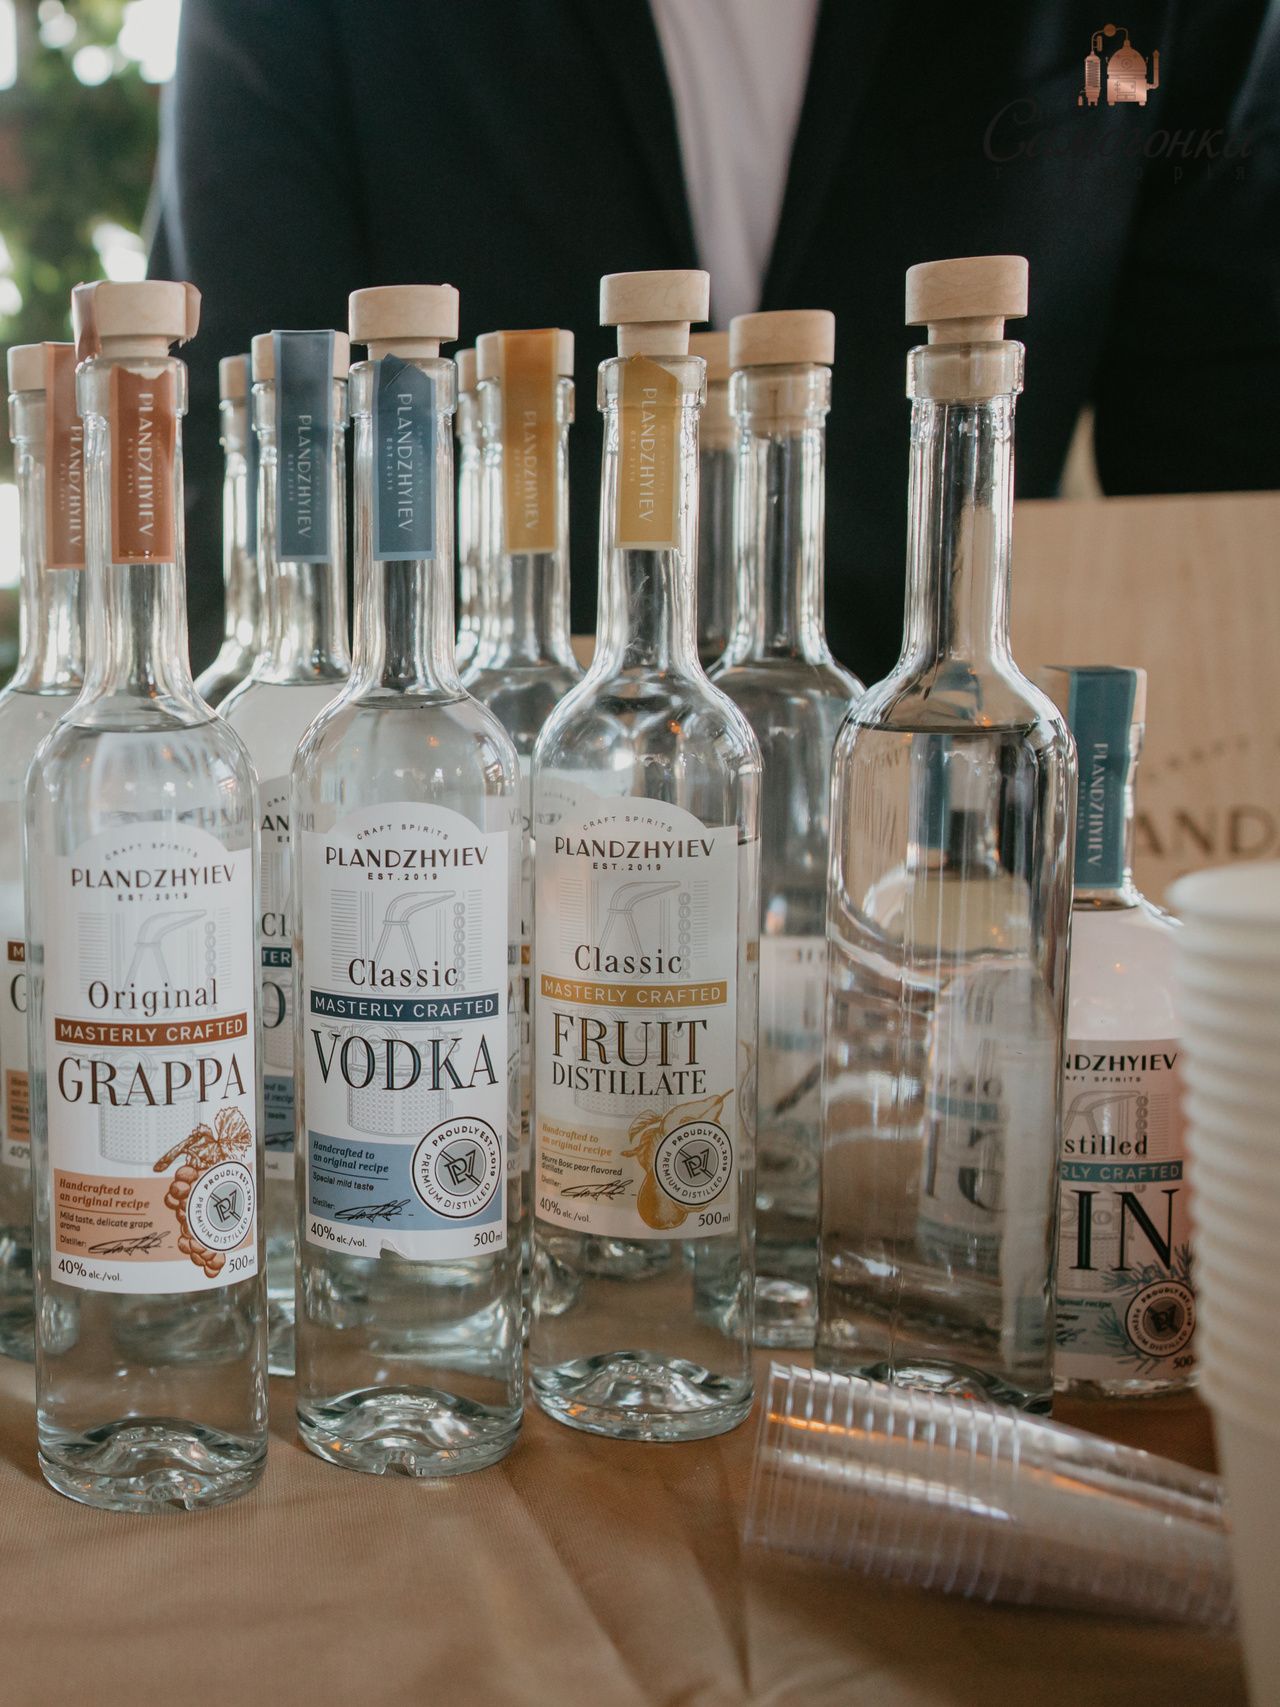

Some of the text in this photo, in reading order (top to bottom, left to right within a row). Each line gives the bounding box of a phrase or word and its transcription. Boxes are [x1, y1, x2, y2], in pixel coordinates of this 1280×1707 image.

[397, 393, 413, 532] PLANDZHYIEV
[638, 388, 657, 523] PLANDZHYIEV
[298, 415, 311, 538] PLANDZHYIEV
[524, 411, 539, 531] PLANDZHYIEV
[1088, 742, 1109, 868] PLANDZHYIEV
[357, 824, 449, 840] CRAFT SPIRITS
[583, 816, 673, 833] CRAFT SPIRITS
[105, 842, 198, 860] CRAFT SPIRITS
[326, 846, 488, 868] PLANDZHYIEV
[555, 836, 715, 859] PLANDZHYIEV
[72, 863, 236, 888] PLANDZHYIEV
[574, 945, 682, 974] Classic
[348, 959, 458, 987] Classic
[88, 979, 218, 1017] Original
[545, 980, 720, 1003] MASTERLY CRAFTED
[315, 996, 493, 1018] MASTERLY CRAFTED
[60, 1019, 242, 1042] MASTERLY CRAFTED
[552, 1012, 707, 1067] FRUIT
[310, 1029, 499, 1091] VODKA
[58, 1052, 247, 1107] GRAPPA
[552, 1061, 707, 1095] DISTILLATE
[432, 1126, 478, 1147] PROUDLY
[543, 1123, 588, 1142] Handcrafted
[672, 1129, 713, 1146] PROUDLY
[313, 1141, 363, 1159] Handcrafted
[551, 1139, 612, 1157] original recipe
[1065, 1135, 1148, 1156] stilled
[314, 1153, 389, 1174] an original recipe
[541, 1153, 622, 1176] Beurre Bosc pear flavored
[541, 1163, 563, 1175] distillate
[1100, 1165, 1180, 1180] CRAFTED
[203, 1169, 240, 1191] PROUDLY
[313, 1171, 374, 1191] Special mild taste
[421, 1153, 491, 1210] PREMIUM DISTILLED
[541, 1176, 562, 1189] Distiller:
[662, 1151, 723, 1199] PREMIUM DISTILLED
[60, 1178, 134, 1196] Handcrafted to
[60, 1192, 150, 1210] an original recipe
[313, 1196, 335, 1210] Distiller:
[539, 1197, 561, 1215] 40%
[60, 1211, 73, 1220] Mild
[97, 1218, 127, 1228] delicate
[130, 1220, 153, 1230] grape
[60, 1224, 80, 1232] aroma
[196, 1197, 249, 1244] PREMIUM DISTILLED
[698, 1212, 730, 1227] 500ml
[1069, 1188, 1180, 1272] IN
[60, 1235, 86, 1247] Distiller:
[310, 1222, 367, 1248] 40% alc./vol.
[474, 1231, 503, 1247] 500ml
[58, 1259, 86, 1278] 40%
[229, 1255, 254, 1273] 500ml
